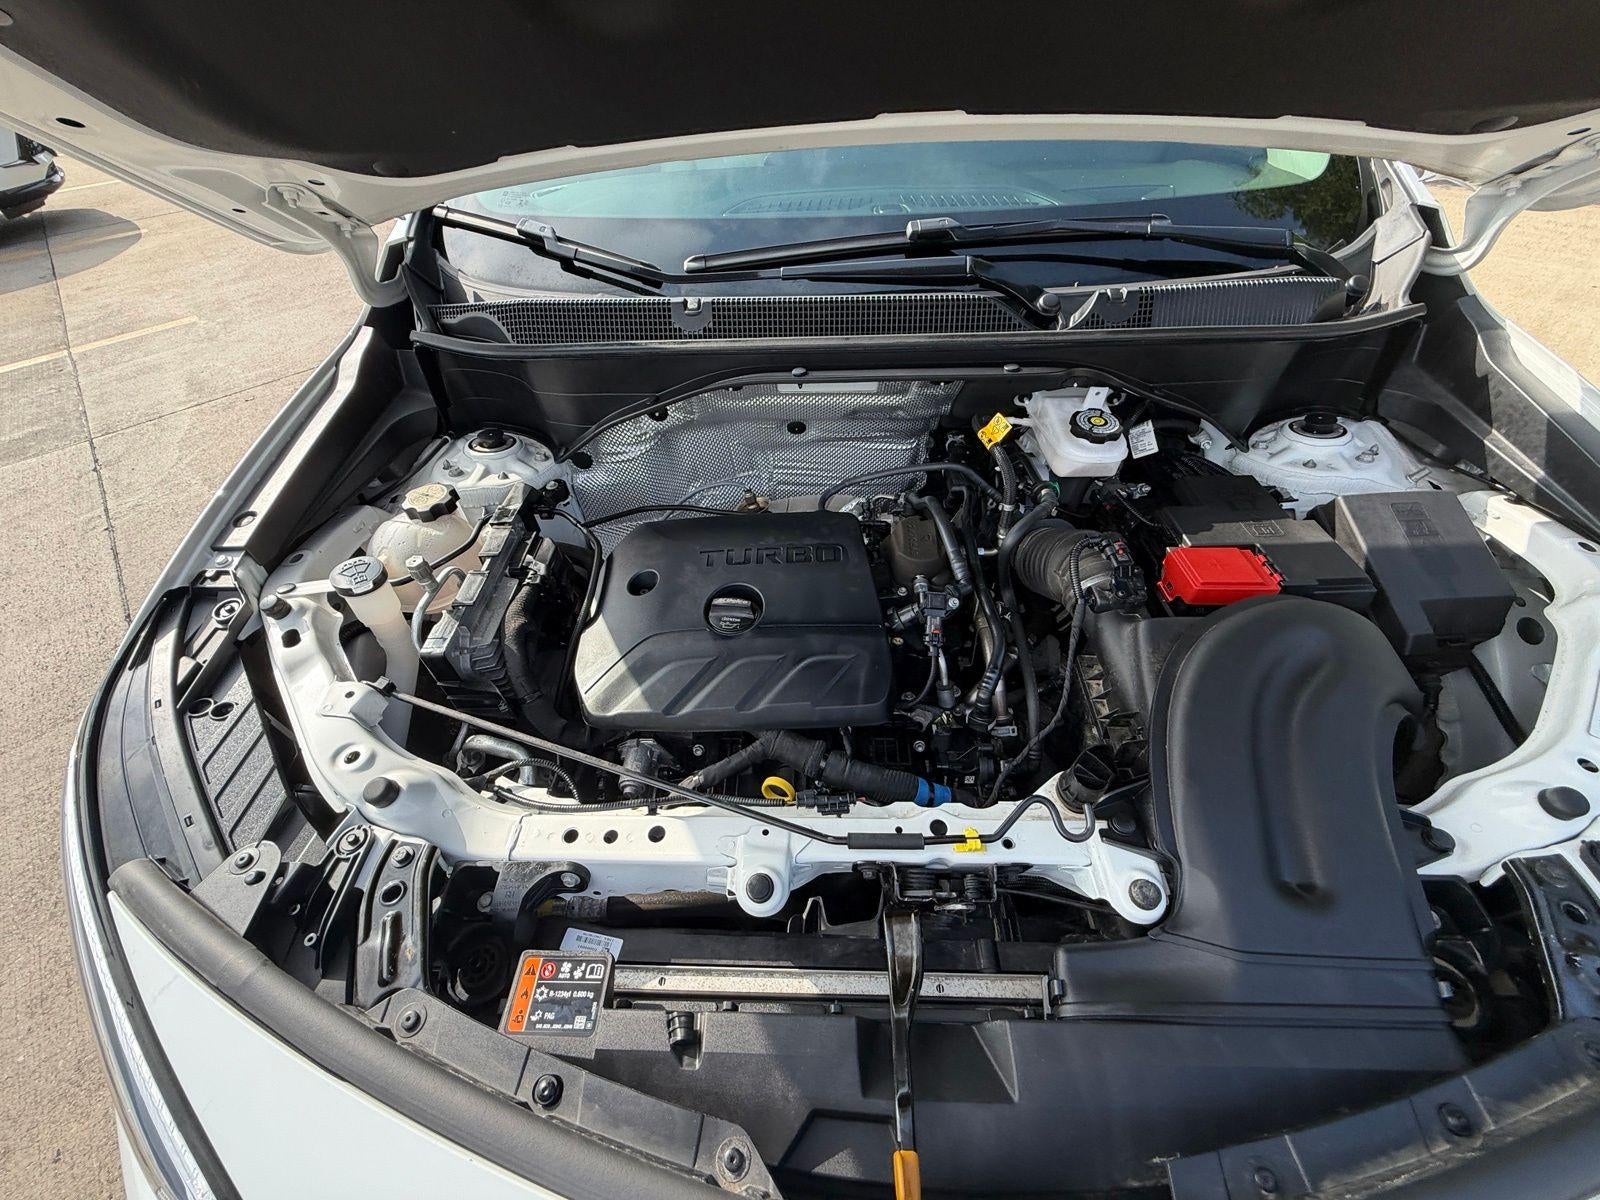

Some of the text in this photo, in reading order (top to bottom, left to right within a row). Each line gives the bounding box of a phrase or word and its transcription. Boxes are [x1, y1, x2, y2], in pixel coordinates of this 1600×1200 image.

[699, 543, 846, 567] TURBO
[548, 990, 571, 999] R-1234yf
[586, 990, 594, 999] kg
[543, 1011, 556, 1020] PAG
